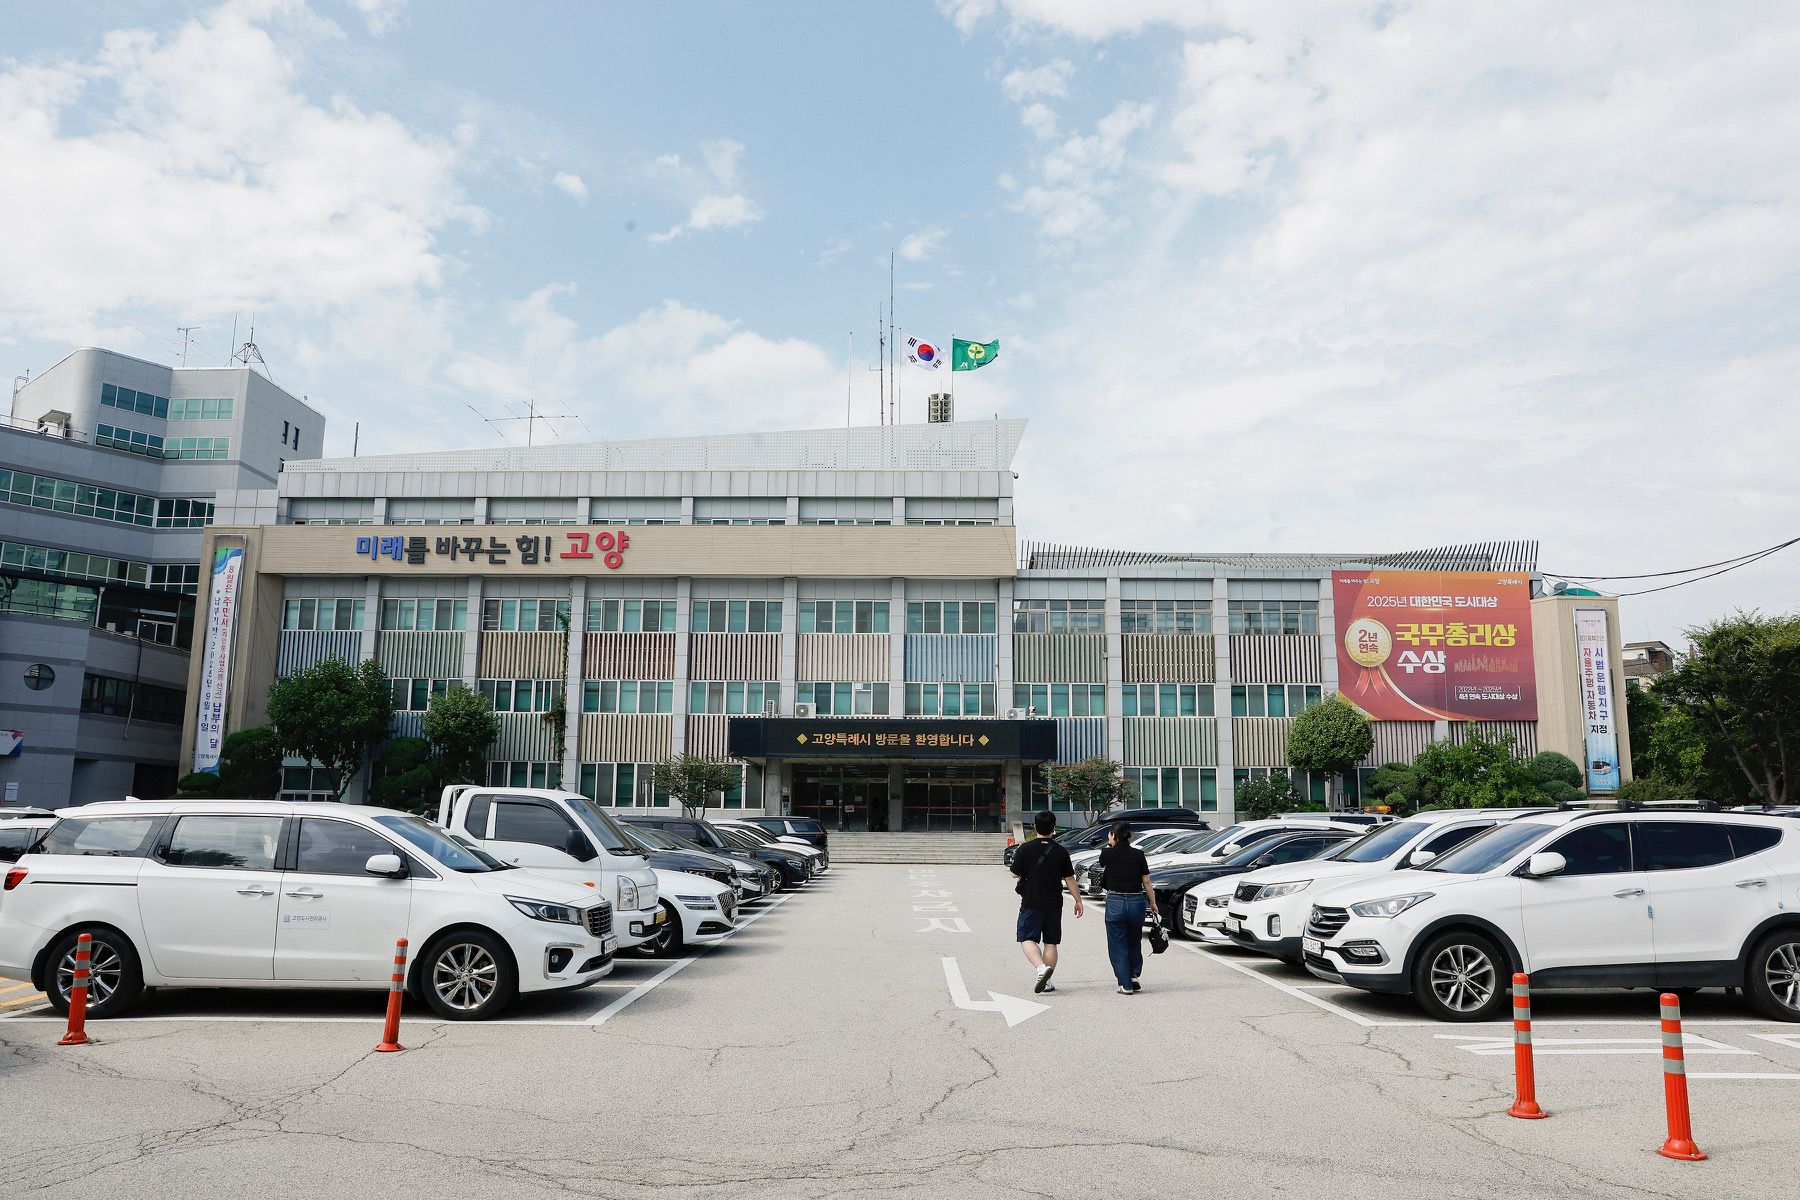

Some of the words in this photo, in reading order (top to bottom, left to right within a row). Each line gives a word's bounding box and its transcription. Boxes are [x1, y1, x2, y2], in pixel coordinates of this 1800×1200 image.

[356, 536, 430, 564] 미래를
[435, 536, 510, 564] 바꾸는
[515, 535, 551, 564] 힘!
[560, 531, 629, 569] 고양
[1367, 595, 1408, 608] 2025년
[1409, 595, 1453, 608] 대한민국
[1455, 596, 1498, 608] 도시대상
[1358, 629, 1378, 643] 2년
[1395, 622, 1518, 647] 국무총리상
[1358, 643, 1379, 654] 연속
[1397, 650, 1446, 674] 수상
[1595, 647, 1609, 720] 시범운행지구
[1586, 690, 1597, 720] 자동차
[201, 713, 209, 732] 1일
[211, 702, 222, 735] 납부의
[1590, 724, 1608, 734] 지정
[210, 738, 219, 749] 달
[811, 732, 871, 745] 고양특례시
[875, 732, 911, 745] 방문을
[915, 733, 975, 747] 환영합니다
